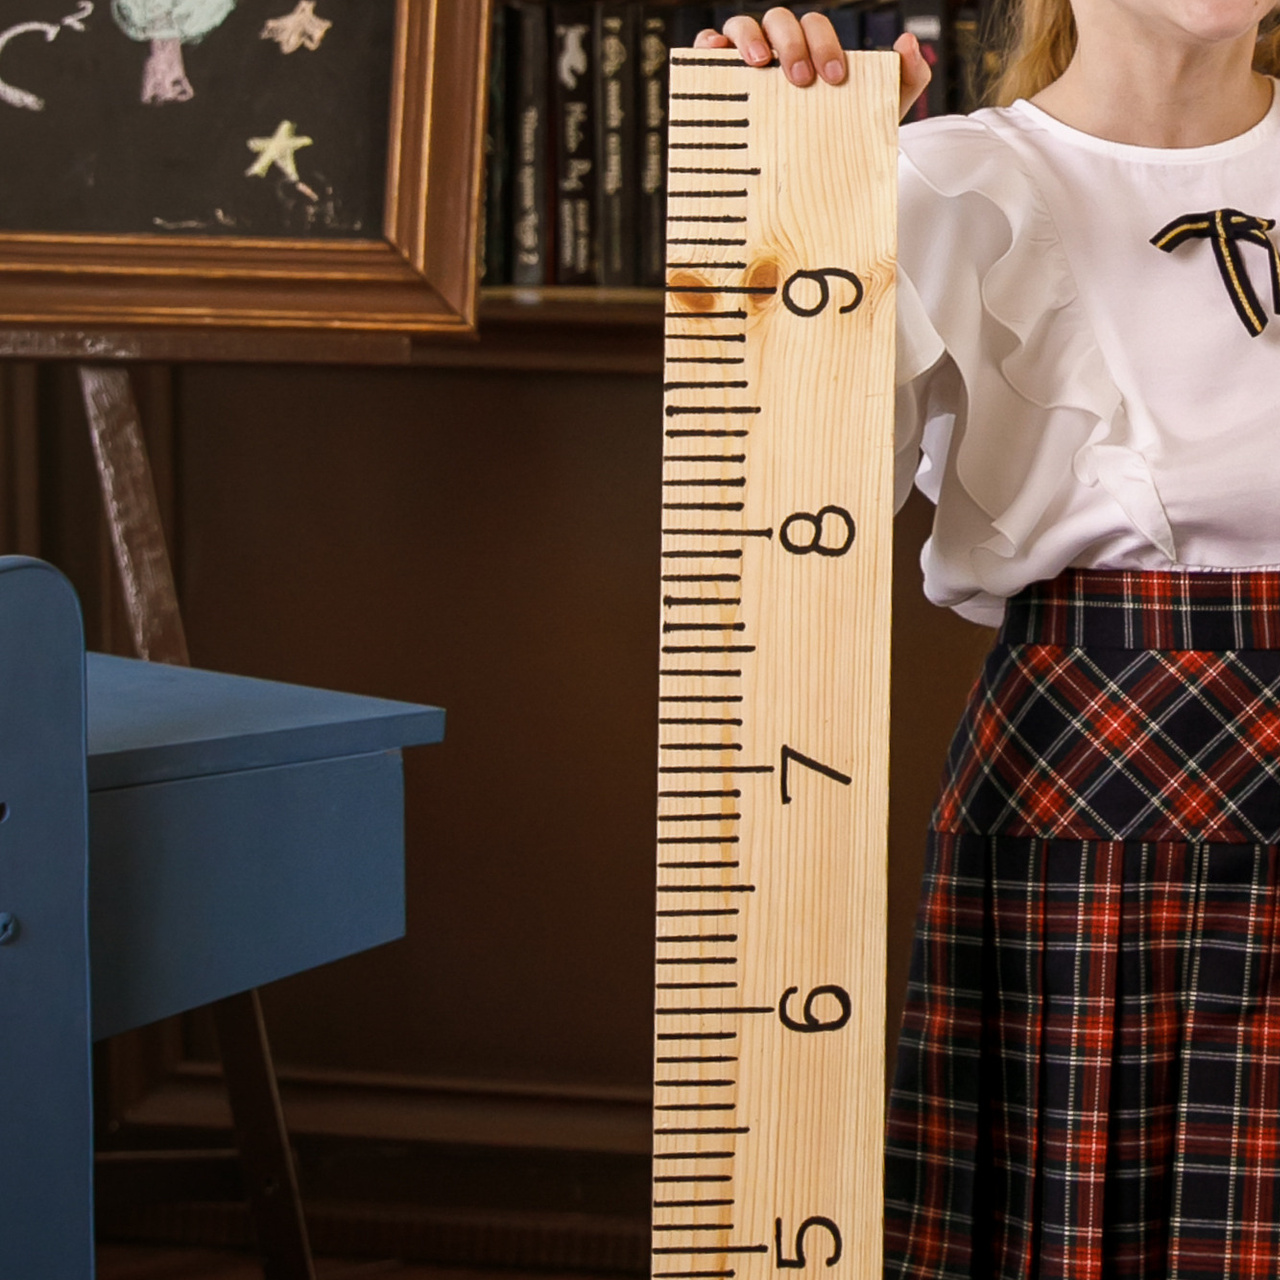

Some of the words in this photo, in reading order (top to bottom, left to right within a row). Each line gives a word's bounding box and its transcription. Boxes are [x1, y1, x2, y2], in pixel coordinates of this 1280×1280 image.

[781, 267, 864, 318] 9
[779, 505, 856, 557] 8
[780, 744, 852, 805] 7
[778, 984, 852, 1034] 6
[774, 1215, 843, 1269] 5
